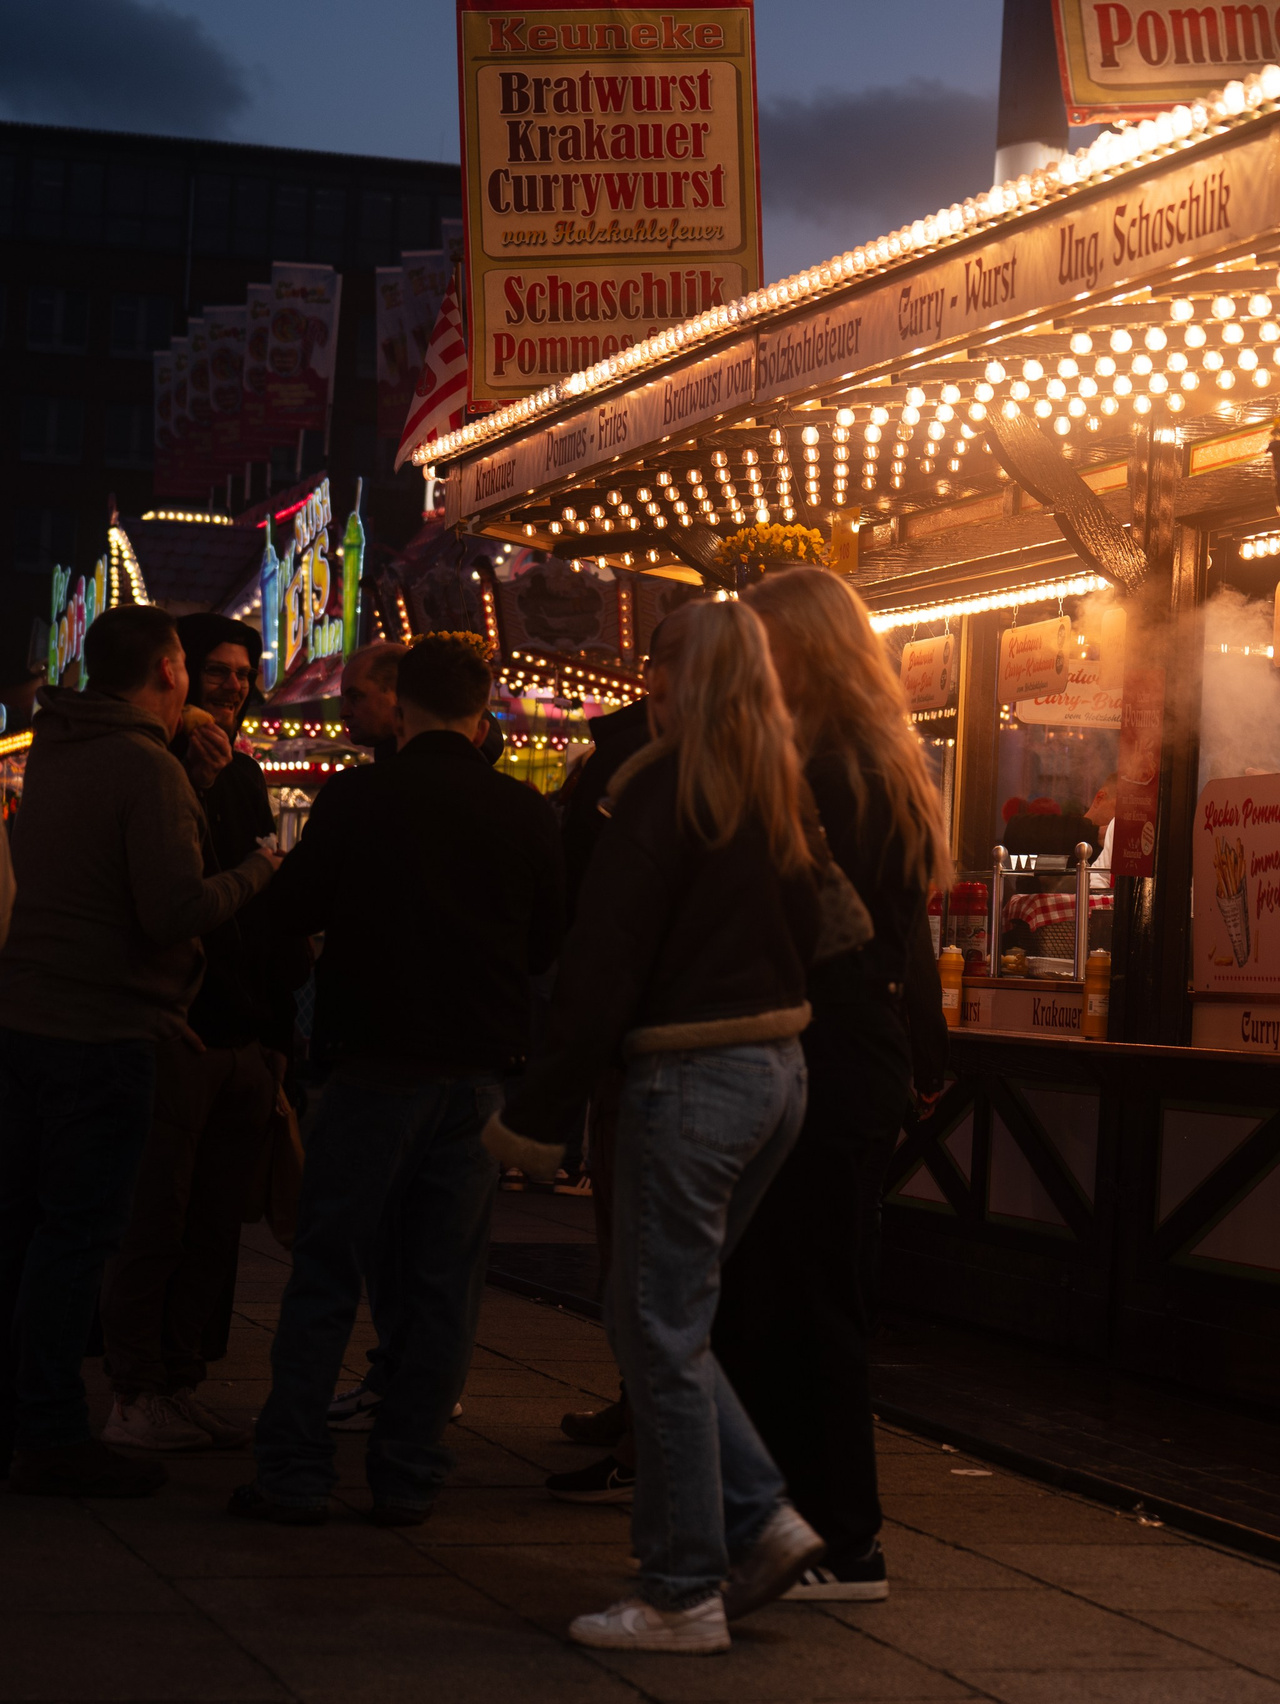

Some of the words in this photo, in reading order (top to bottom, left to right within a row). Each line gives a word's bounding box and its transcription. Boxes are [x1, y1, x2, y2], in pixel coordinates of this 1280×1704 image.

[487, 15, 725, 53] Keuneke
[500, 68, 713, 115] Bratwurst
[506, 118, 709, 163] Krakauer
[487, 163, 726, 217] Currywurst
[501, 226, 547, 247] vom
[552, 218, 724, 248] Holzkohlefeuer
[1057, 223, 1104, 289] Ung.
[1112, 168, 1232, 266] Schaschlik
[504, 270, 725, 325] Schaschlik
[964, 246, 1017, 316] Wurst
[663, 368, 723, 426] Bratwurst
[726, 355, 752, 395] vom
[755, 315, 862, 391] Holzkohlefeuer
[475, 457, 518, 502] Krakauer
[285, 527, 331, 671] EIS
[1204, 800, 1241, 835] Lecker
[1032, 997, 1083, 1029] Krakauer
